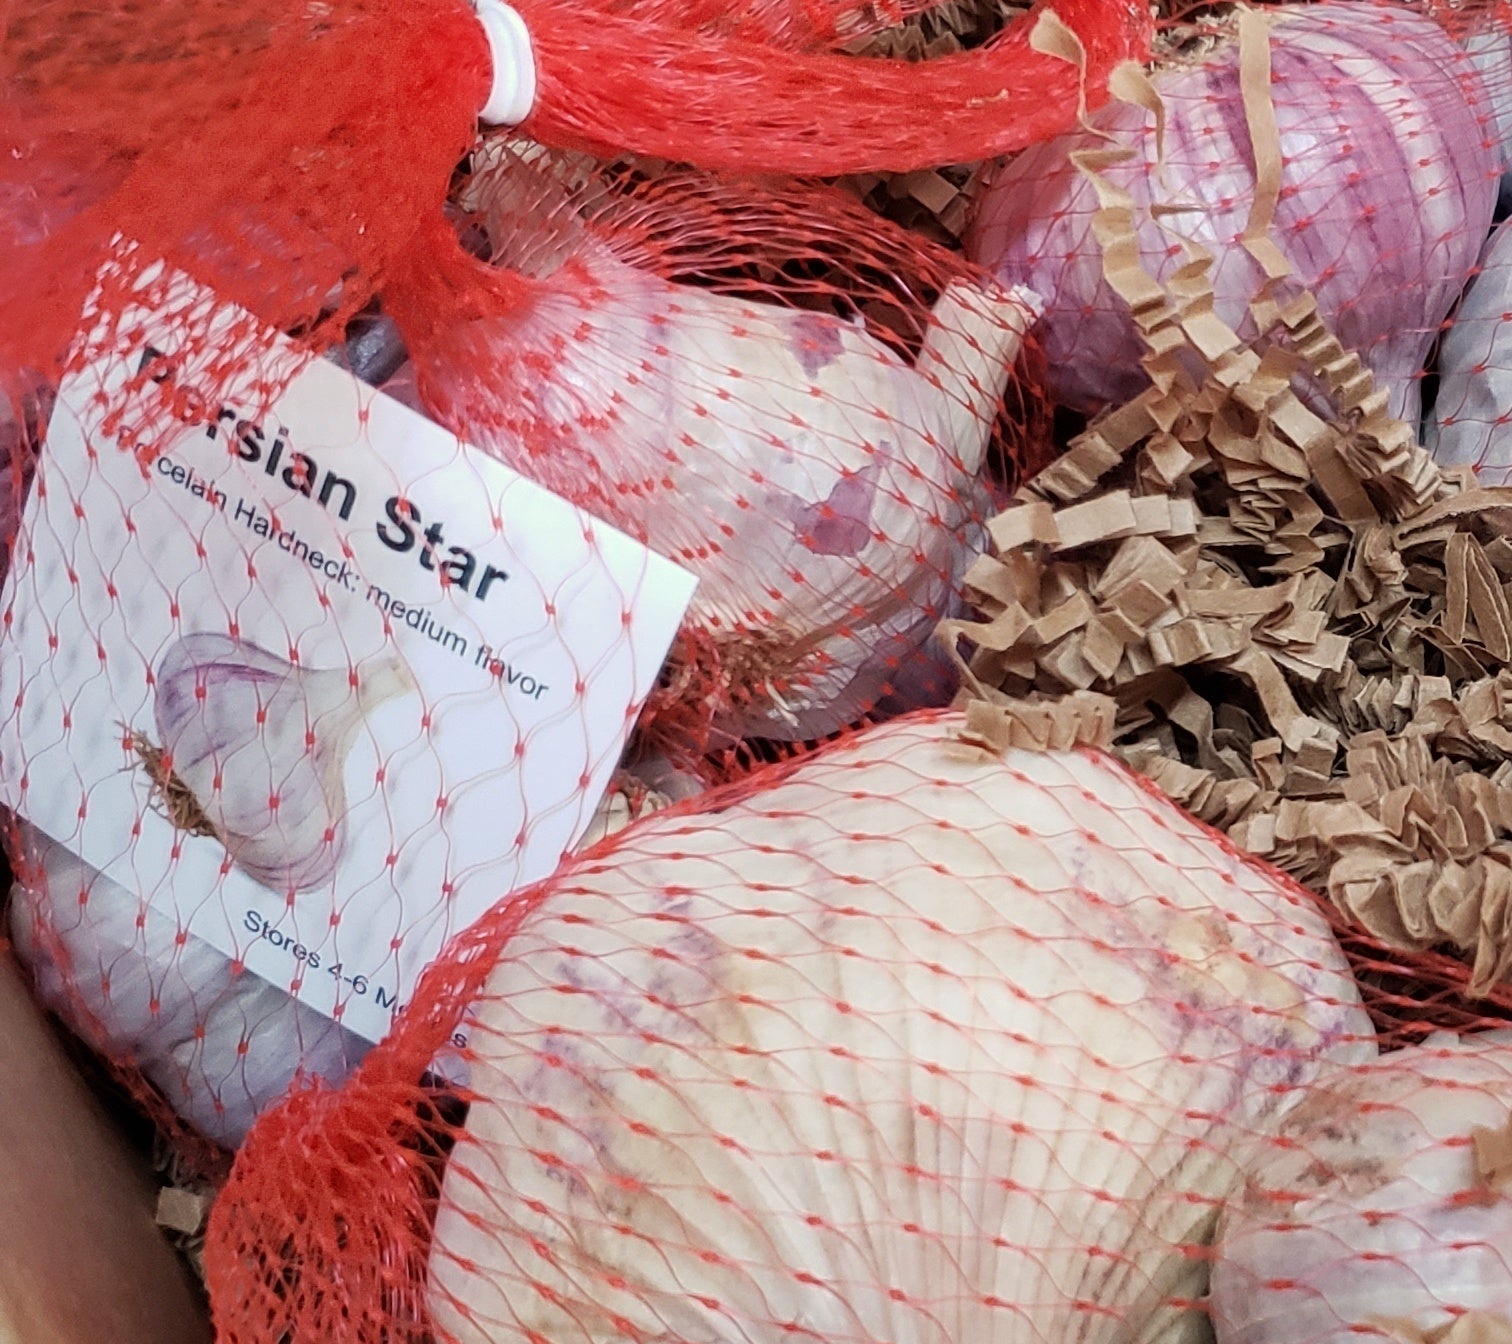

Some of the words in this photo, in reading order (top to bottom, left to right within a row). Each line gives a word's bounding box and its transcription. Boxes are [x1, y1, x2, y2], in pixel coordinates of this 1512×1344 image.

[233, 497, 360, 592] Hardneck:
[366, 584, 468, 656] medium
[475, 644, 549, 701] flavor
[376, 496, 509, 602] Star
[243, 910, 322, 968] Stores
[328, 963, 370, 995] 4-6
